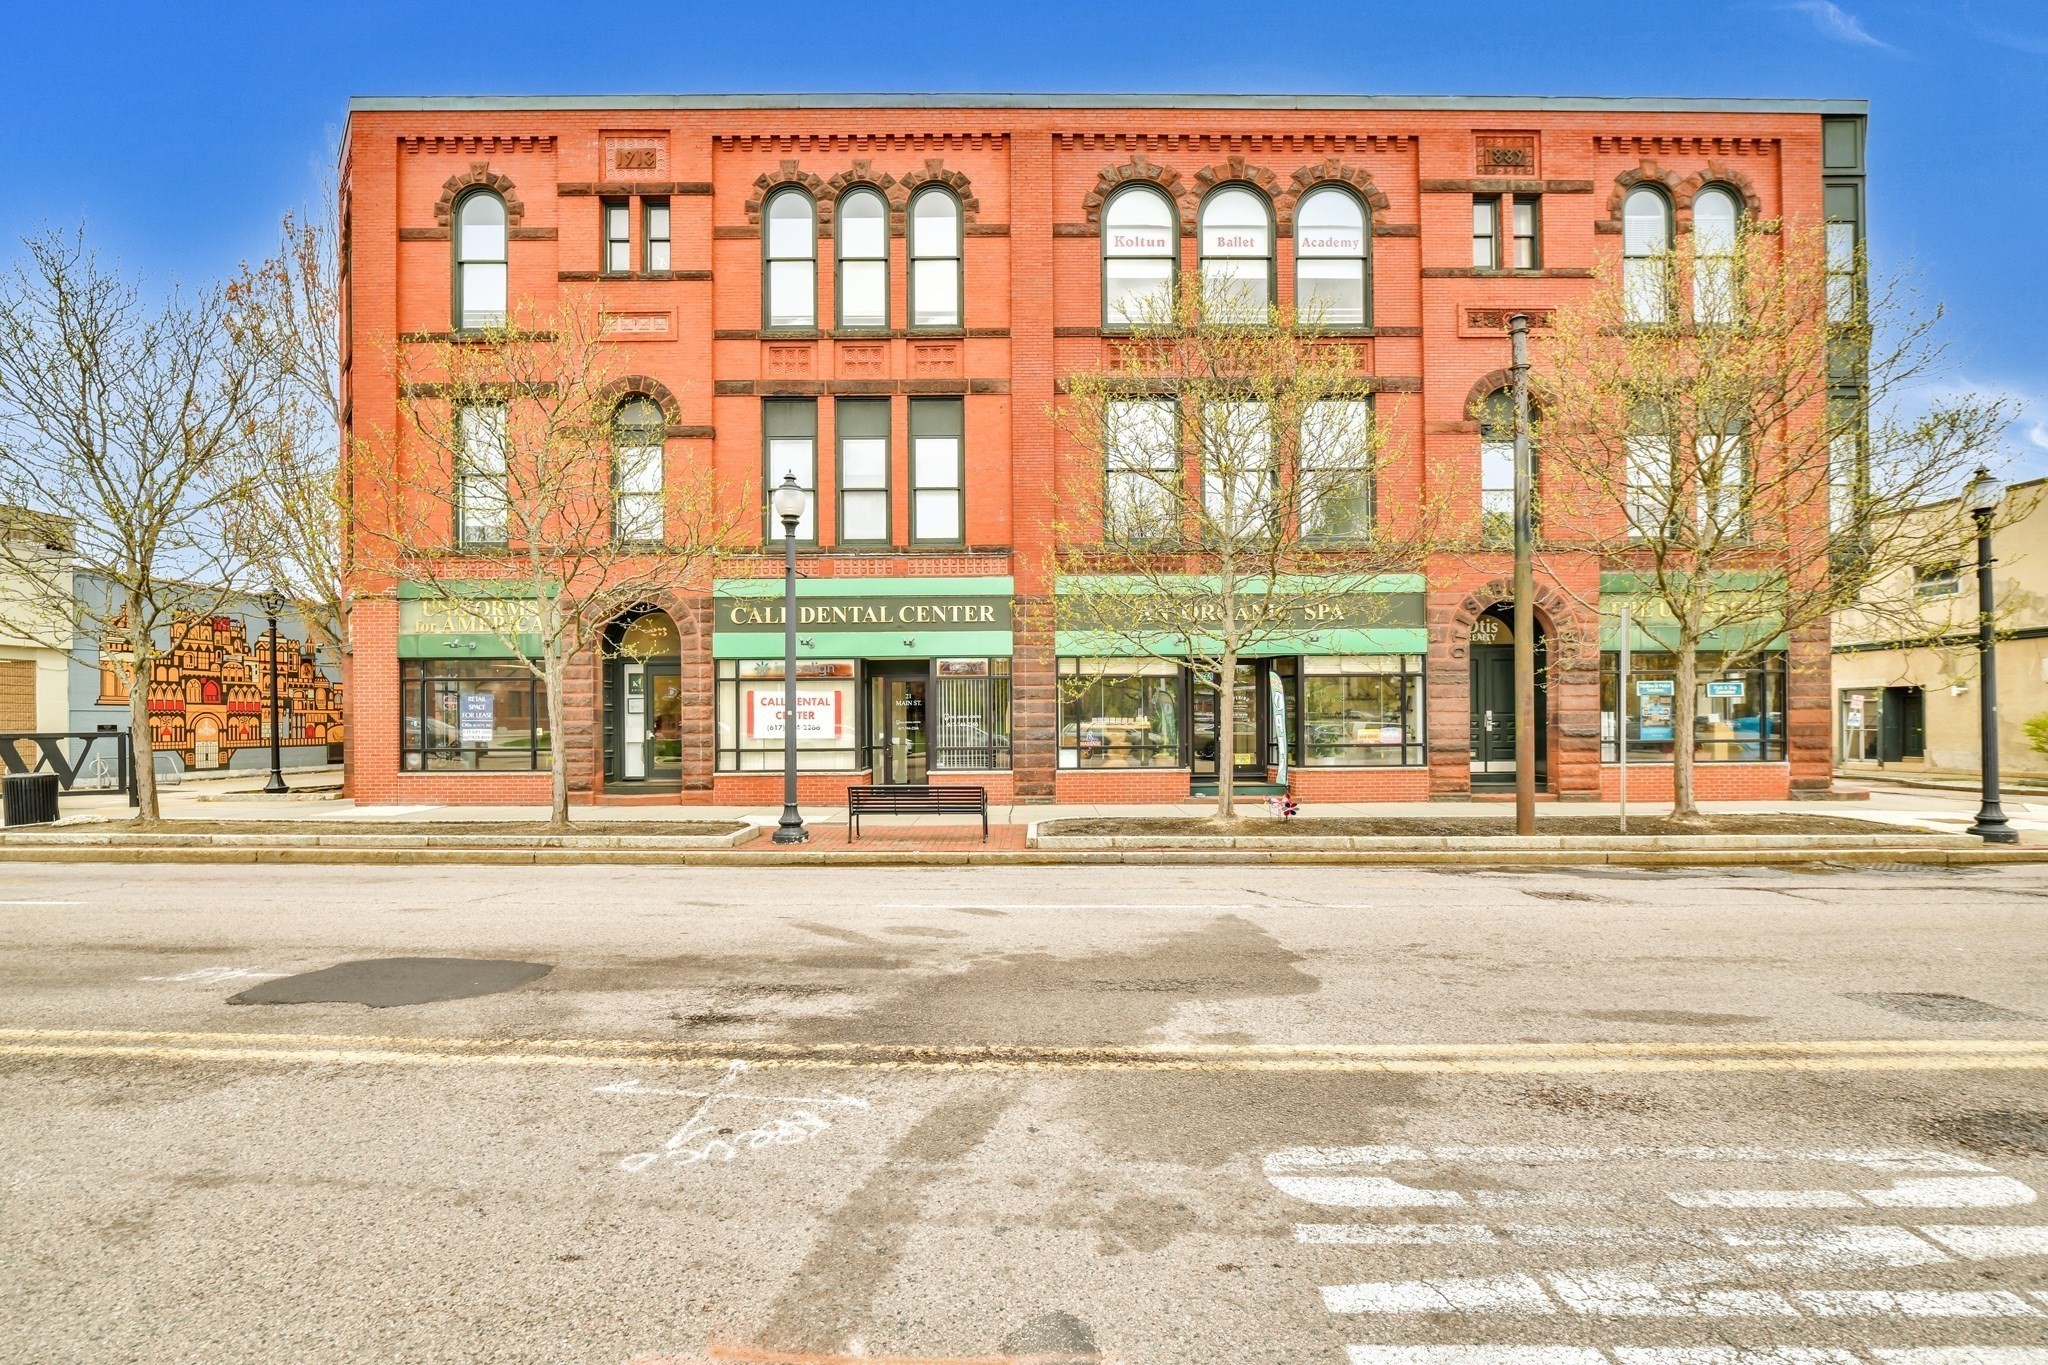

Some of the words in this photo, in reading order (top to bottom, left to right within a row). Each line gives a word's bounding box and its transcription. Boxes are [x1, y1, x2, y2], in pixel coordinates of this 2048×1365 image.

[617, 149, 655, 167] 1913
[1485, 148, 1523, 165] 1889
[1114, 235, 1166, 248] Koltun
[1217, 236, 1255, 249] Ballet
[1302, 236, 1360, 250] Academy
[799, 605, 894, 624] DENTAL
[899, 605, 996, 623] CENTER
[1304, 603, 1346, 621] SPA
[415, 620, 437, 633] for
[1470, 618, 1498, 634] Otis
[774, 661, 835, 676] insalign
[760, 698, 786, 706] CALL
[797, 698, 831, 706] ENTAL
[776, 712, 815, 720] CTER
